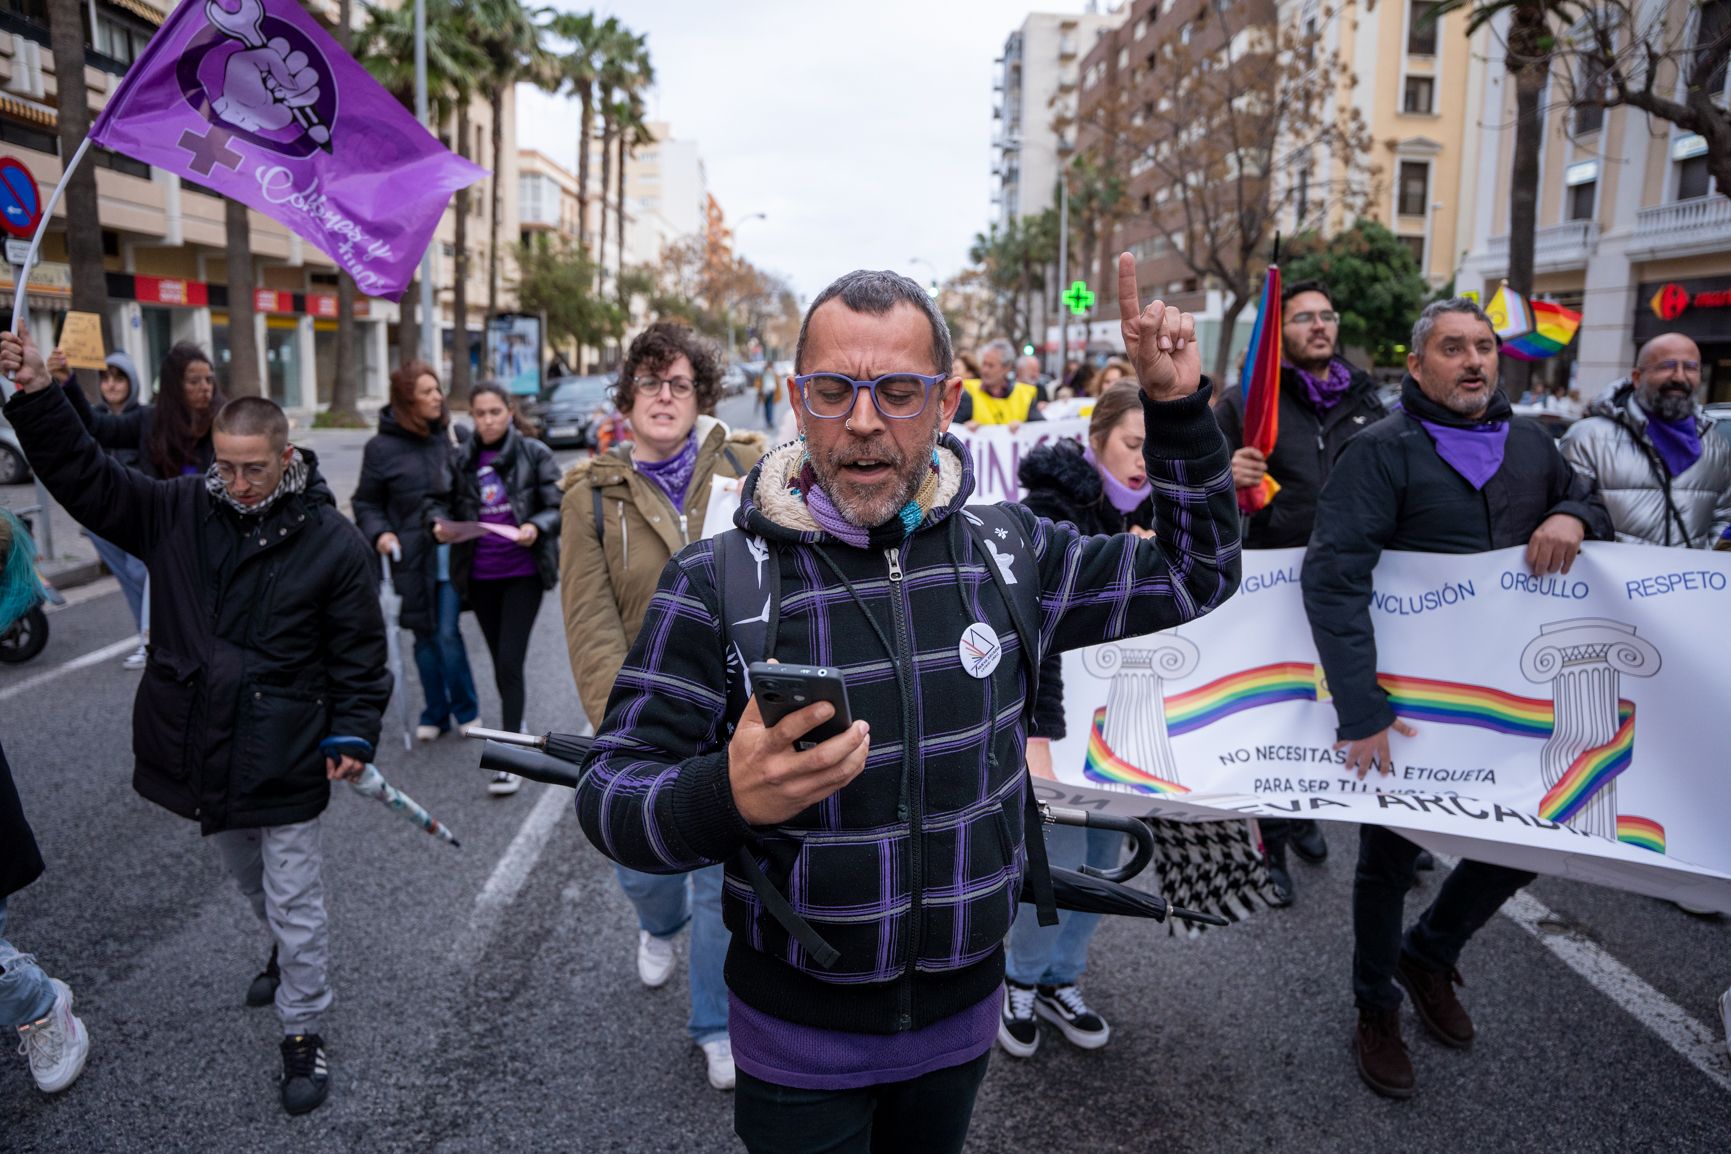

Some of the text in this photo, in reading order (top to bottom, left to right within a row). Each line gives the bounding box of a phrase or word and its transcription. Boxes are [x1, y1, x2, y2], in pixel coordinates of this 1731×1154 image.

[1240, 567, 1727, 616] IGUAL NCLUSIÓN ORGULLO RESPETO
[1218, 748, 1251, 766] NO
[1255, 745, 1348, 765] NECESITAS
[1403, 765, 1497, 785] ETIQUETA
[1254, 778, 1295, 793] PARA
[1298, 778, 1330, 793] SER
